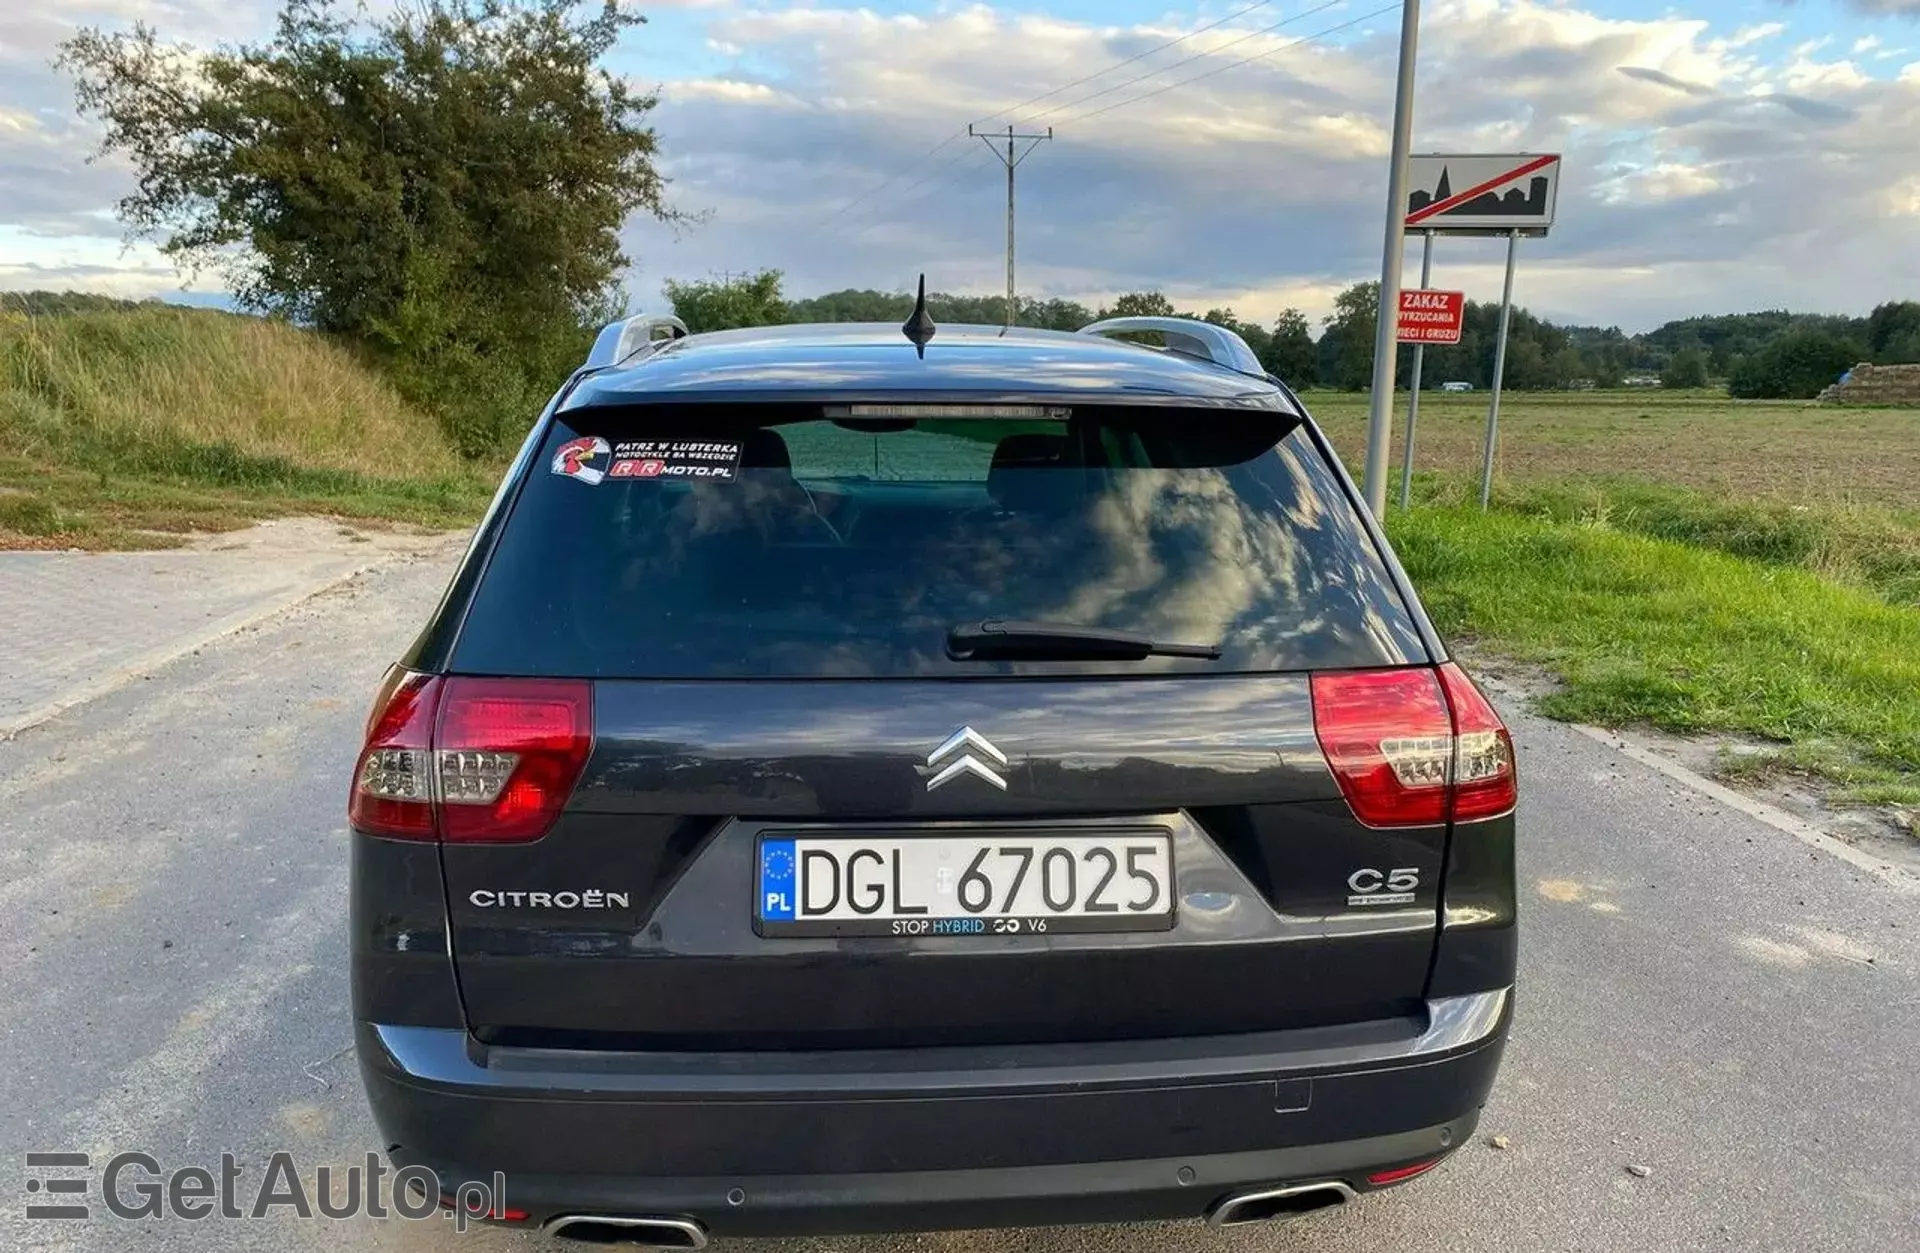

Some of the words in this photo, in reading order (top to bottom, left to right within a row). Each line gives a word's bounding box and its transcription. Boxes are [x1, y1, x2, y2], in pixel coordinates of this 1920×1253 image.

[1403, 294, 1449, 309] ZAKAZ
[1420, 328, 1425, 338] I
[1426, 328, 1458, 340] GRUZU
[615, 442, 655, 451] PATRZ
[658, 442, 669, 451] W
[671, 442, 738, 453] LUSTERKA
[767, 893, 791, 911] PL
[801, 848, 928, 915] DGL
[957, 847, 1160, 914] 67025
[1347, 868, 1419, 893] C5
[469, 889, 629, 908] CITROËN
[892, 920, 929, 934] STOP
[933, 919, 986, 933] HYBRID
[1028, 919, 1047, 933] V6
